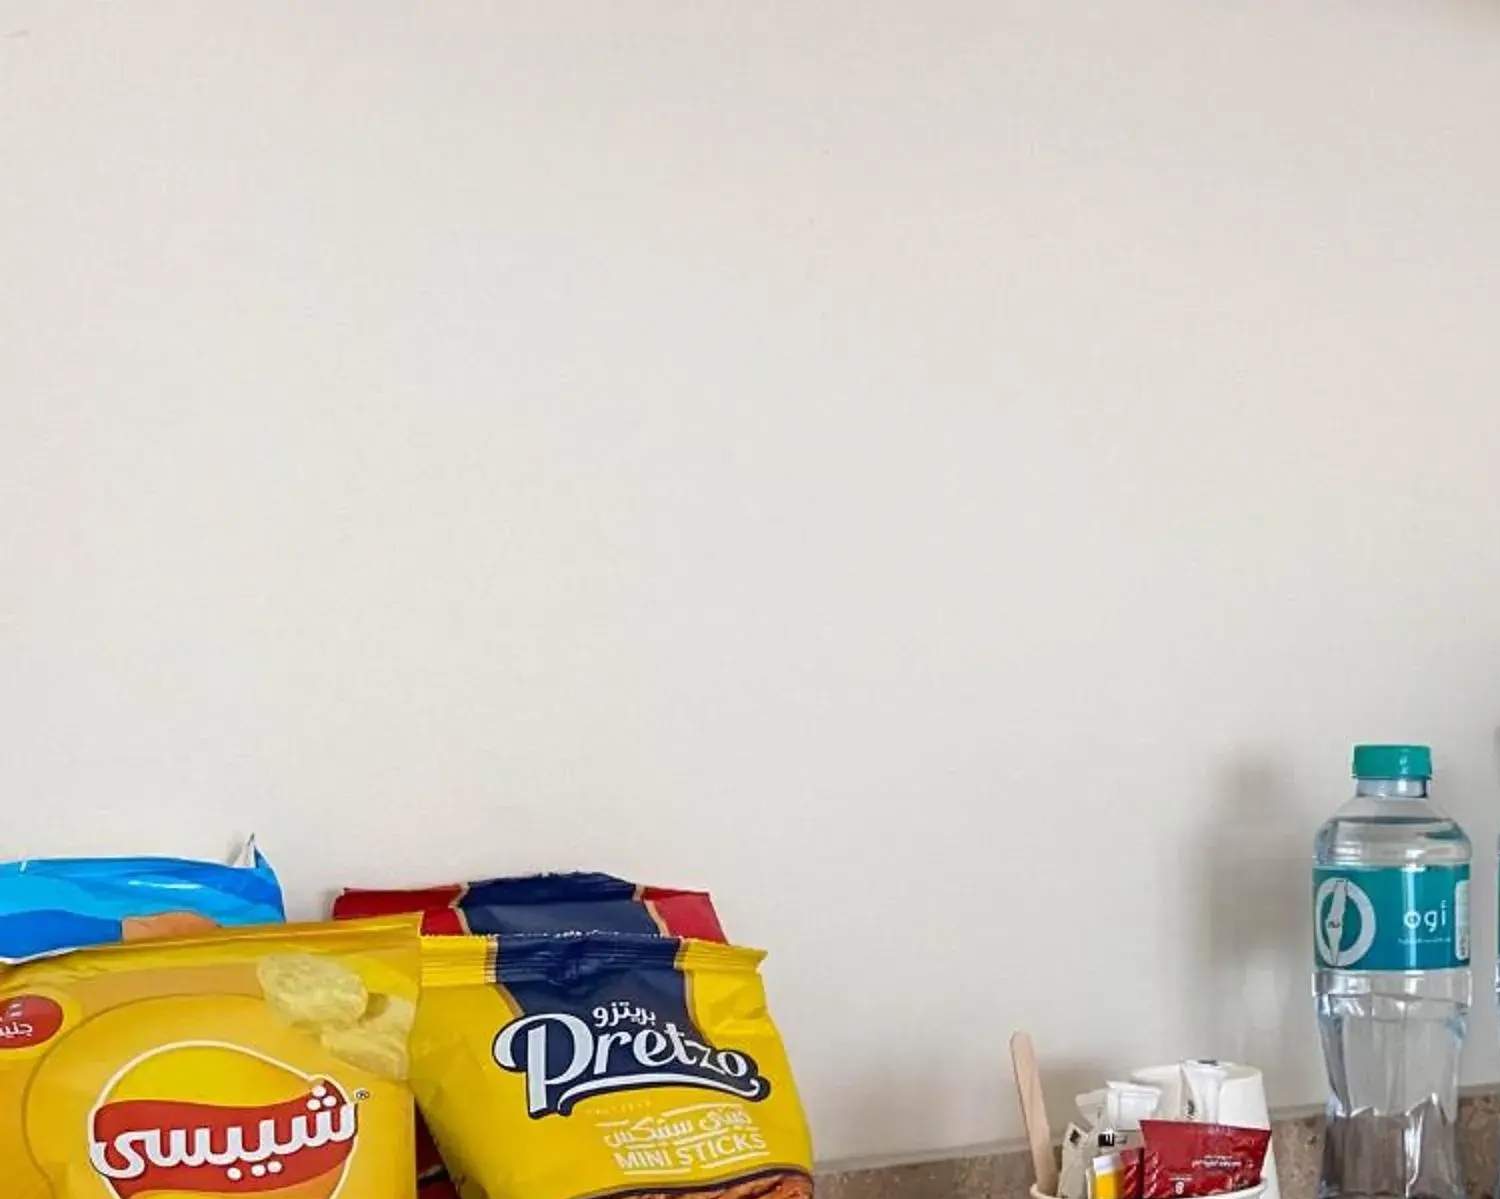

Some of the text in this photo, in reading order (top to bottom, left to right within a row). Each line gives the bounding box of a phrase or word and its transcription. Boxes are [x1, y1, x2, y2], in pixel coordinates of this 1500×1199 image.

[493, 1012, 753, 1113] Pretzo
[613, 1132, 767, 1169] MINI STICKS
